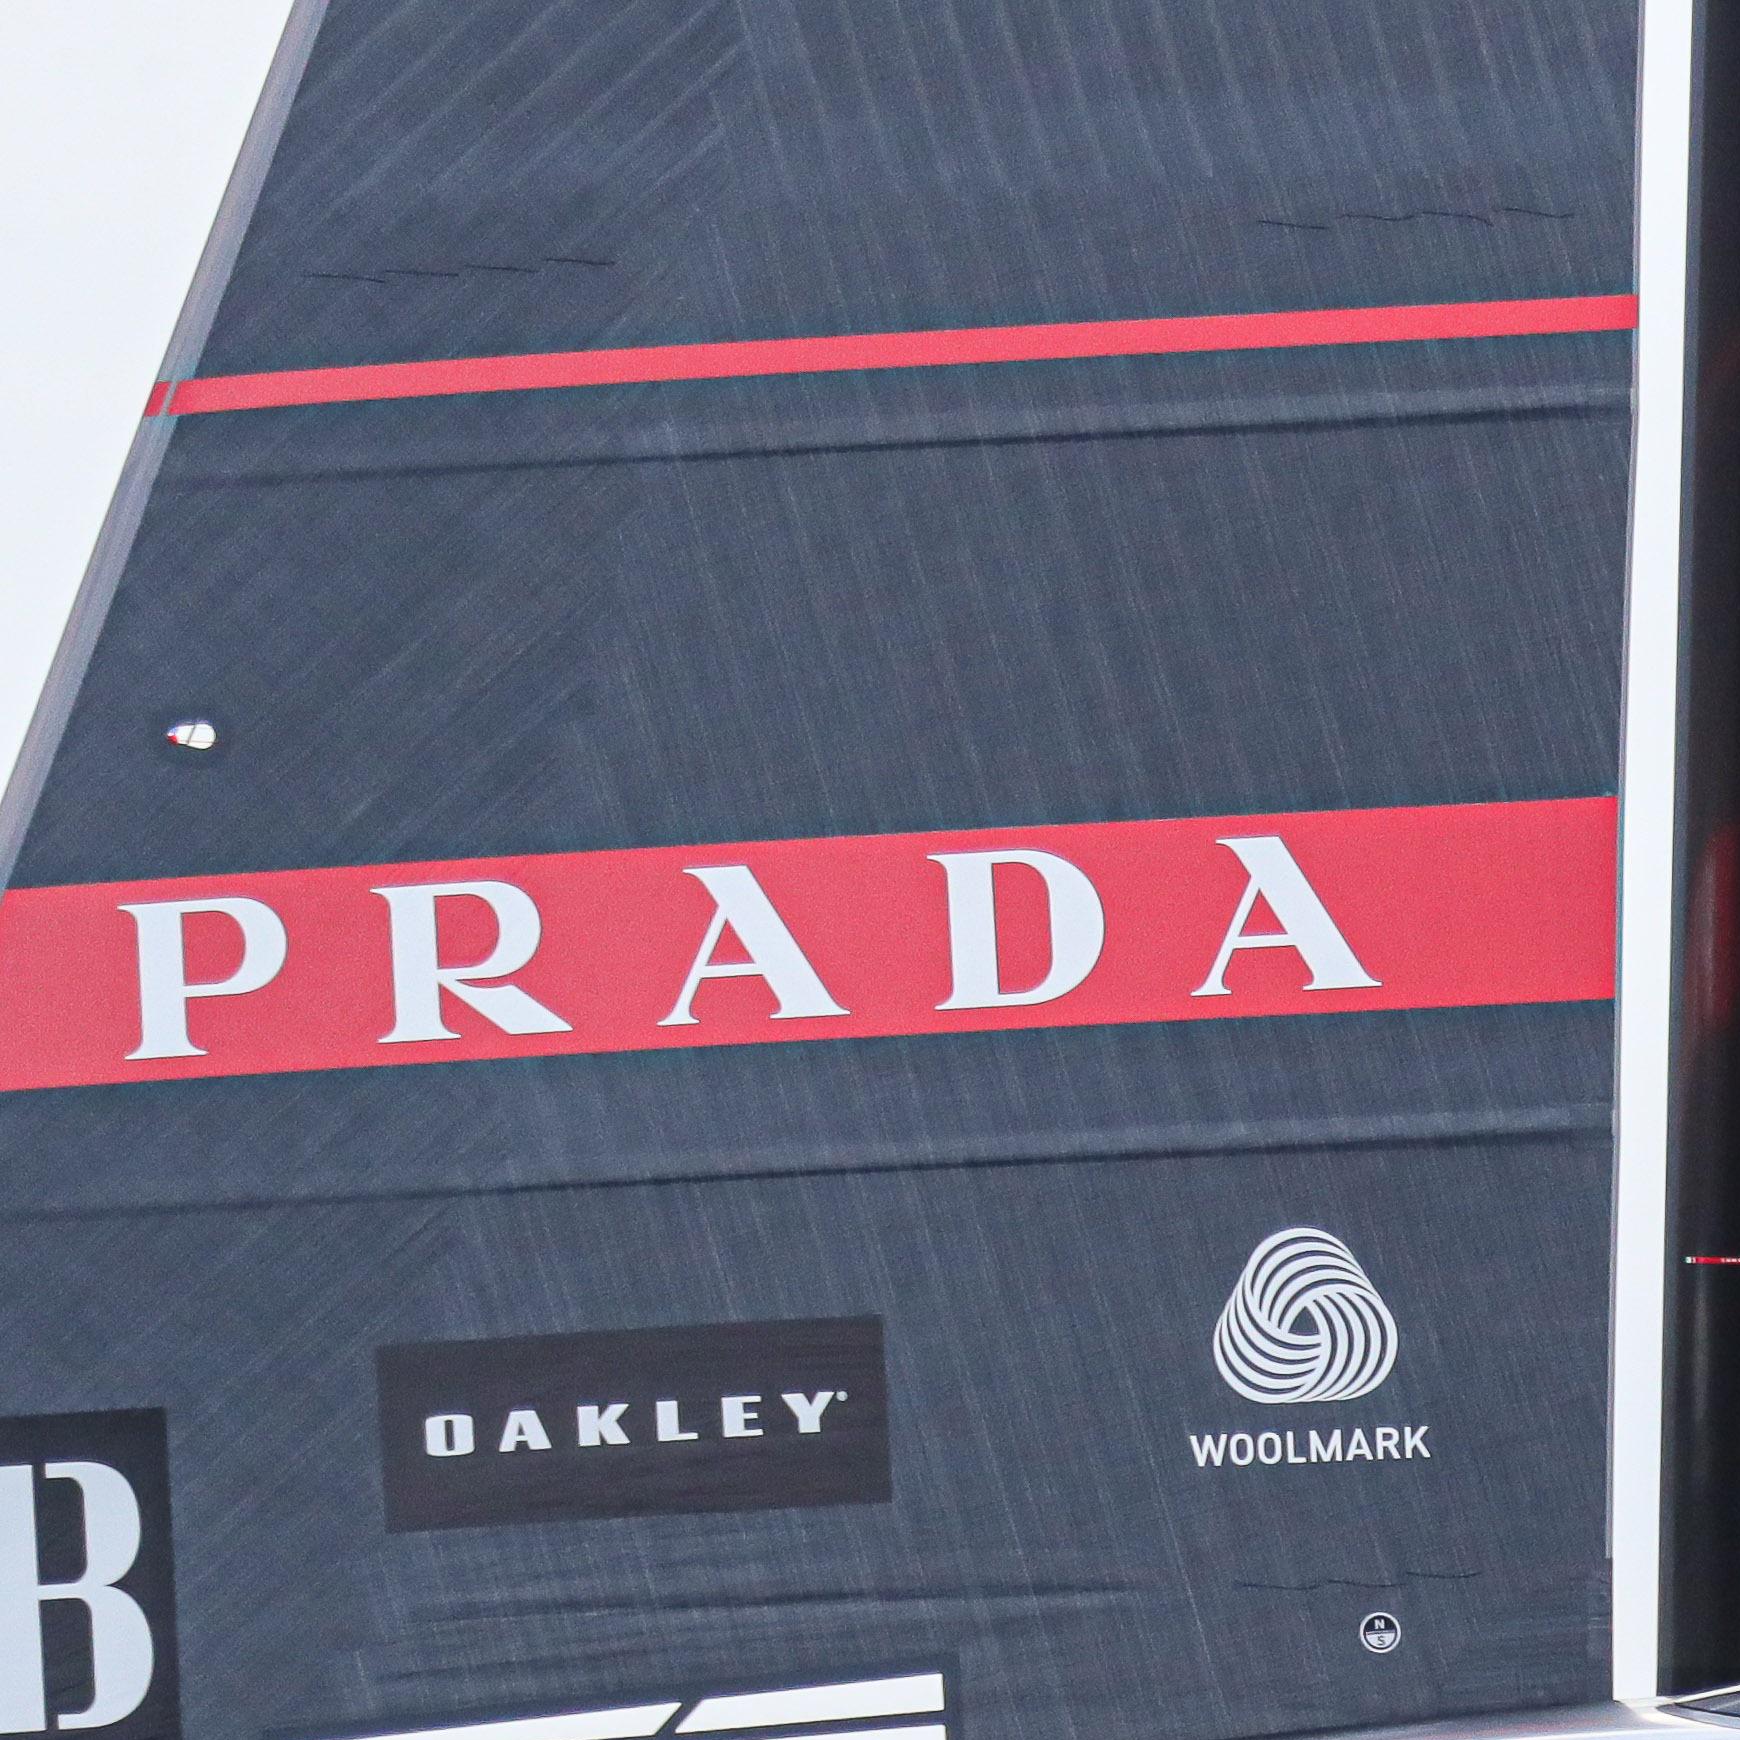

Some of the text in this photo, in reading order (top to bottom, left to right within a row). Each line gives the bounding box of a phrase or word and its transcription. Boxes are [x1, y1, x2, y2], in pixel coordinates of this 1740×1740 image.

[117, 835, 1382, 1062] PRADA
[424, 1390, 836, 1457] OAKLEY
[1190, 1425, 1431, 1468] WOOLMARK
